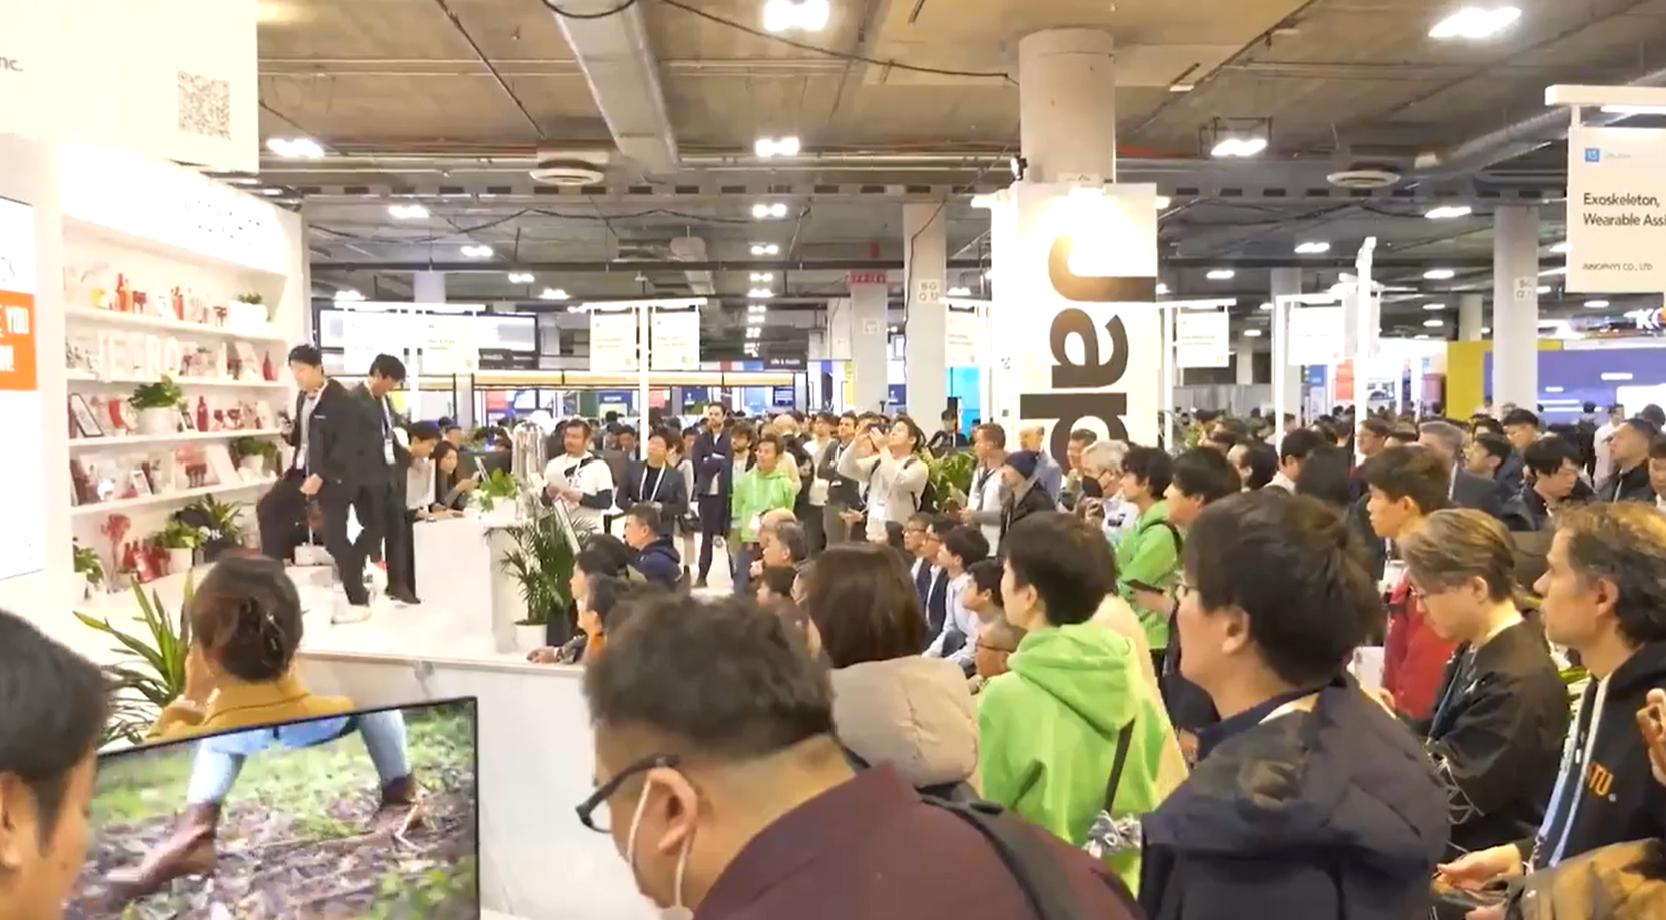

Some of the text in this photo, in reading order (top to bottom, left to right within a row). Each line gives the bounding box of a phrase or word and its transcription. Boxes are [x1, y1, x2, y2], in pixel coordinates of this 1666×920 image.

[1583, 192, 1661, 208] Exoskeleton,
[1583, 212, 1641, 227] Wearable
[6, 305, 28, 334] YOU
